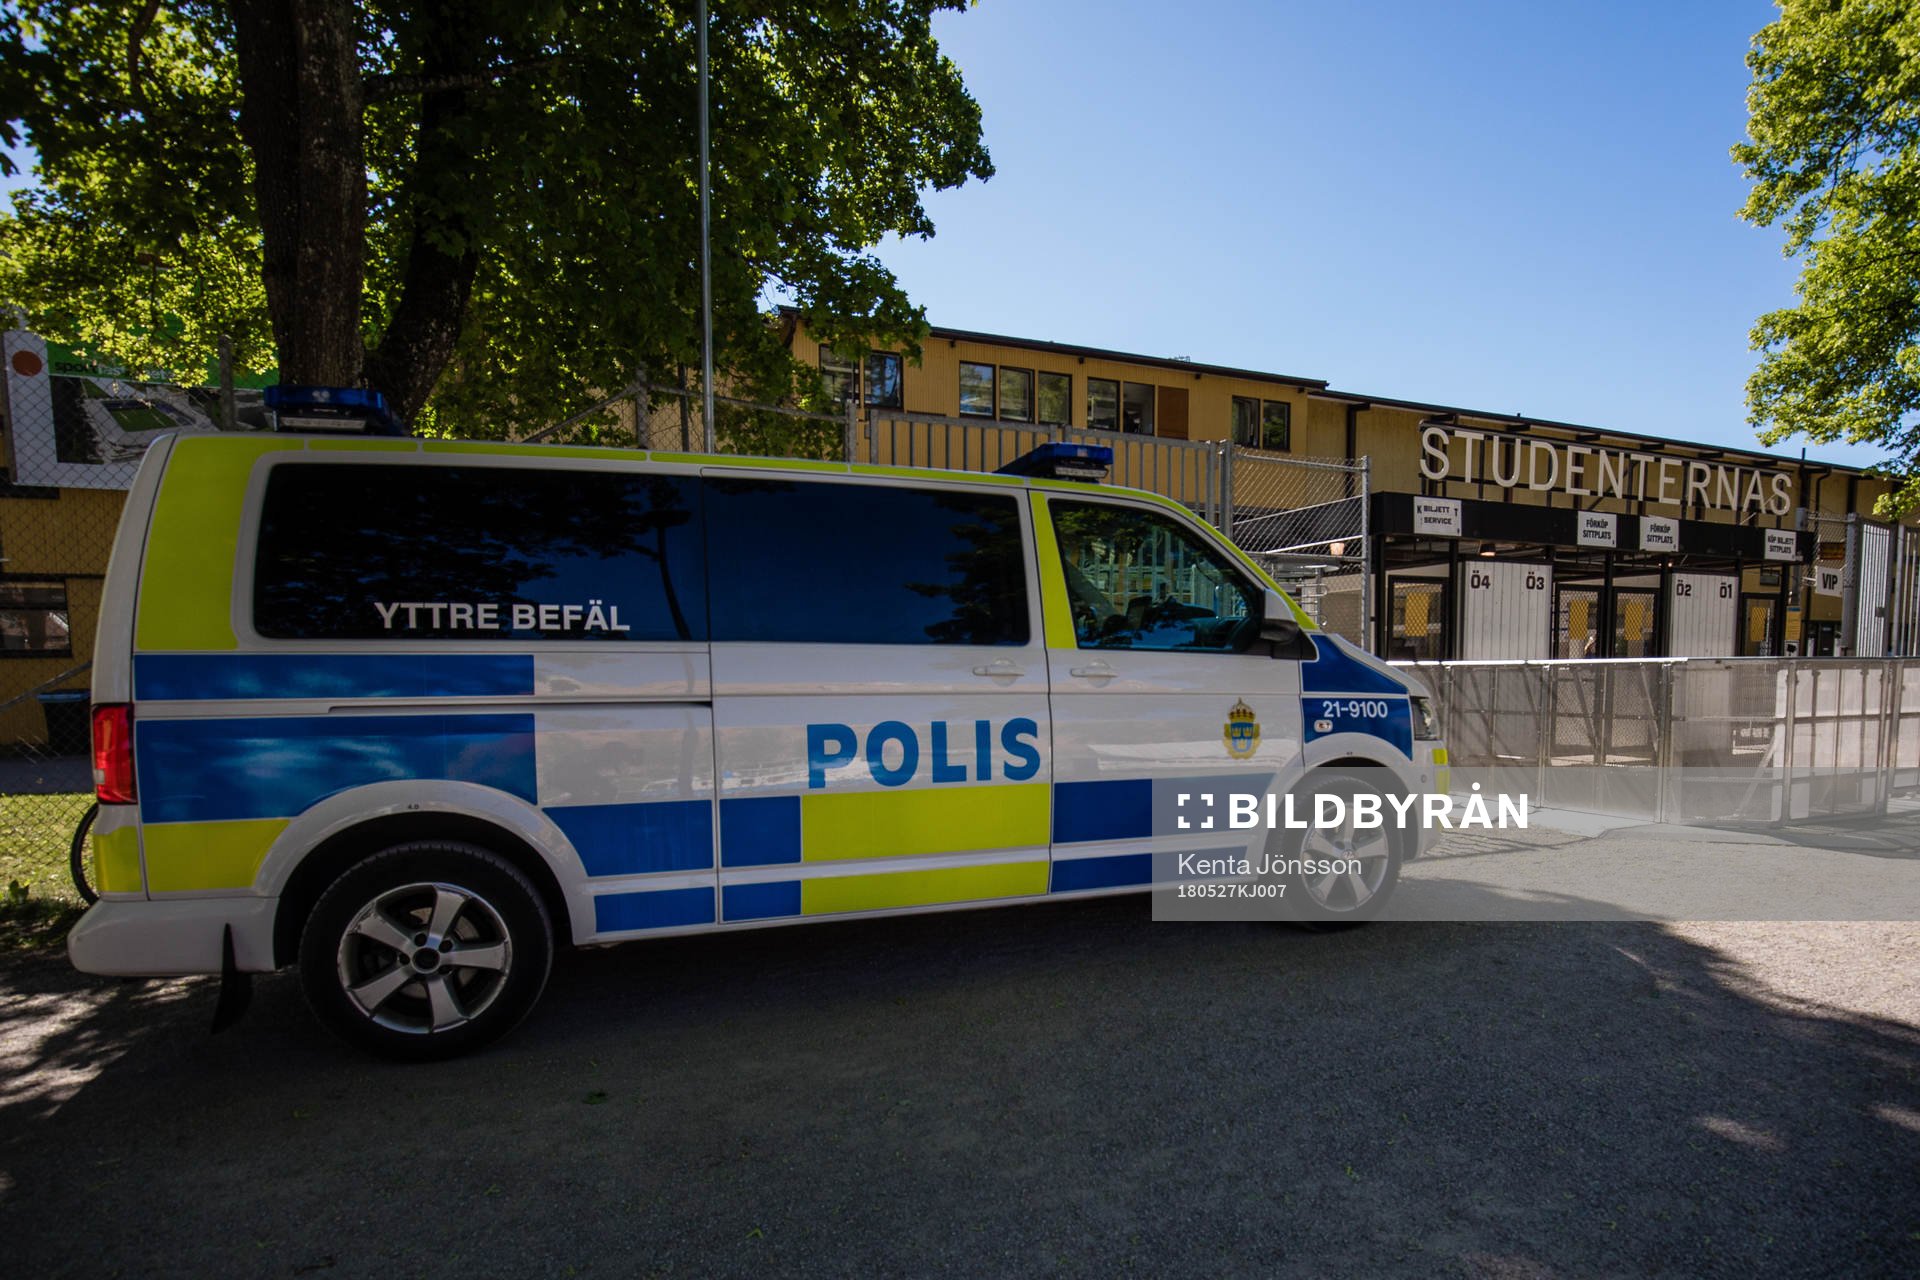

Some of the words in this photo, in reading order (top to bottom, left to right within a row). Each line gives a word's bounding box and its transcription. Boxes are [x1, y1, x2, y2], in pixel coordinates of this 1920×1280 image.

[1420, 427, 1792, 516] STUDENTERNAS
[1424, 505, 1450, 513] BILJETT
[1424, 516, 1452, 525] SERVICE
[1586, 518, 1608, 529] FÖRKÖP
[1650, 523, 1671, 534] FÖRKÖP
[1583, 529, 1611, 540] SITTPLATS
[1646, 534, 1673, 544] SITTPLATS
[1471, 570, 1491, 590] Ö4
[1526, 571, 1545, 591] Ö3
[1676, 579, 1692, 597] Ö2
[1822, 572, 1838, 590] VIP
[1719, 582, 1733, 599] Ö1
[374, 602, 500, 630] YTTRE
[512, 599, 631, 631] BEFÄL
[1322, 700, 1388, 719] 21-9100
[806, 717, 1041, 789] POLIS
